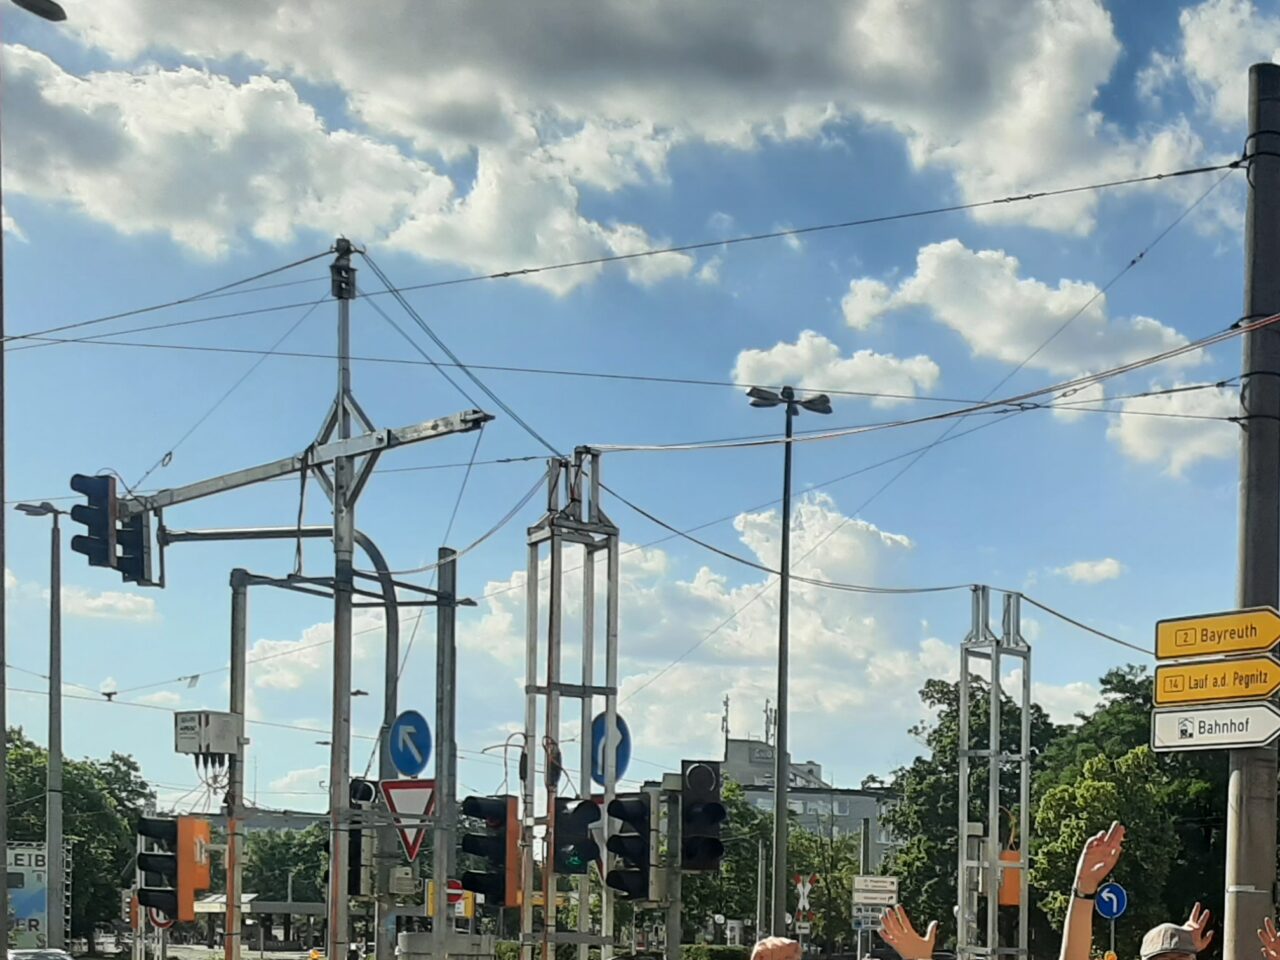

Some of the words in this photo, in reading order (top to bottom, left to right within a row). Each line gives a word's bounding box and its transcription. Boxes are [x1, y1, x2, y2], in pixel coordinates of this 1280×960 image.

[1183, 631, 1189, 643] 2
[1200, 624, 1257, 645] Bayreuth
[1169, 679, 1178, 689] 14
[1188, 674, 1208, 690] Lauf
[1212, 672, 1229, 689] a.d.
[1232, 669, 1268, 689] Pegnitz
[1198, 717, 1250, 735] Bahnhof
